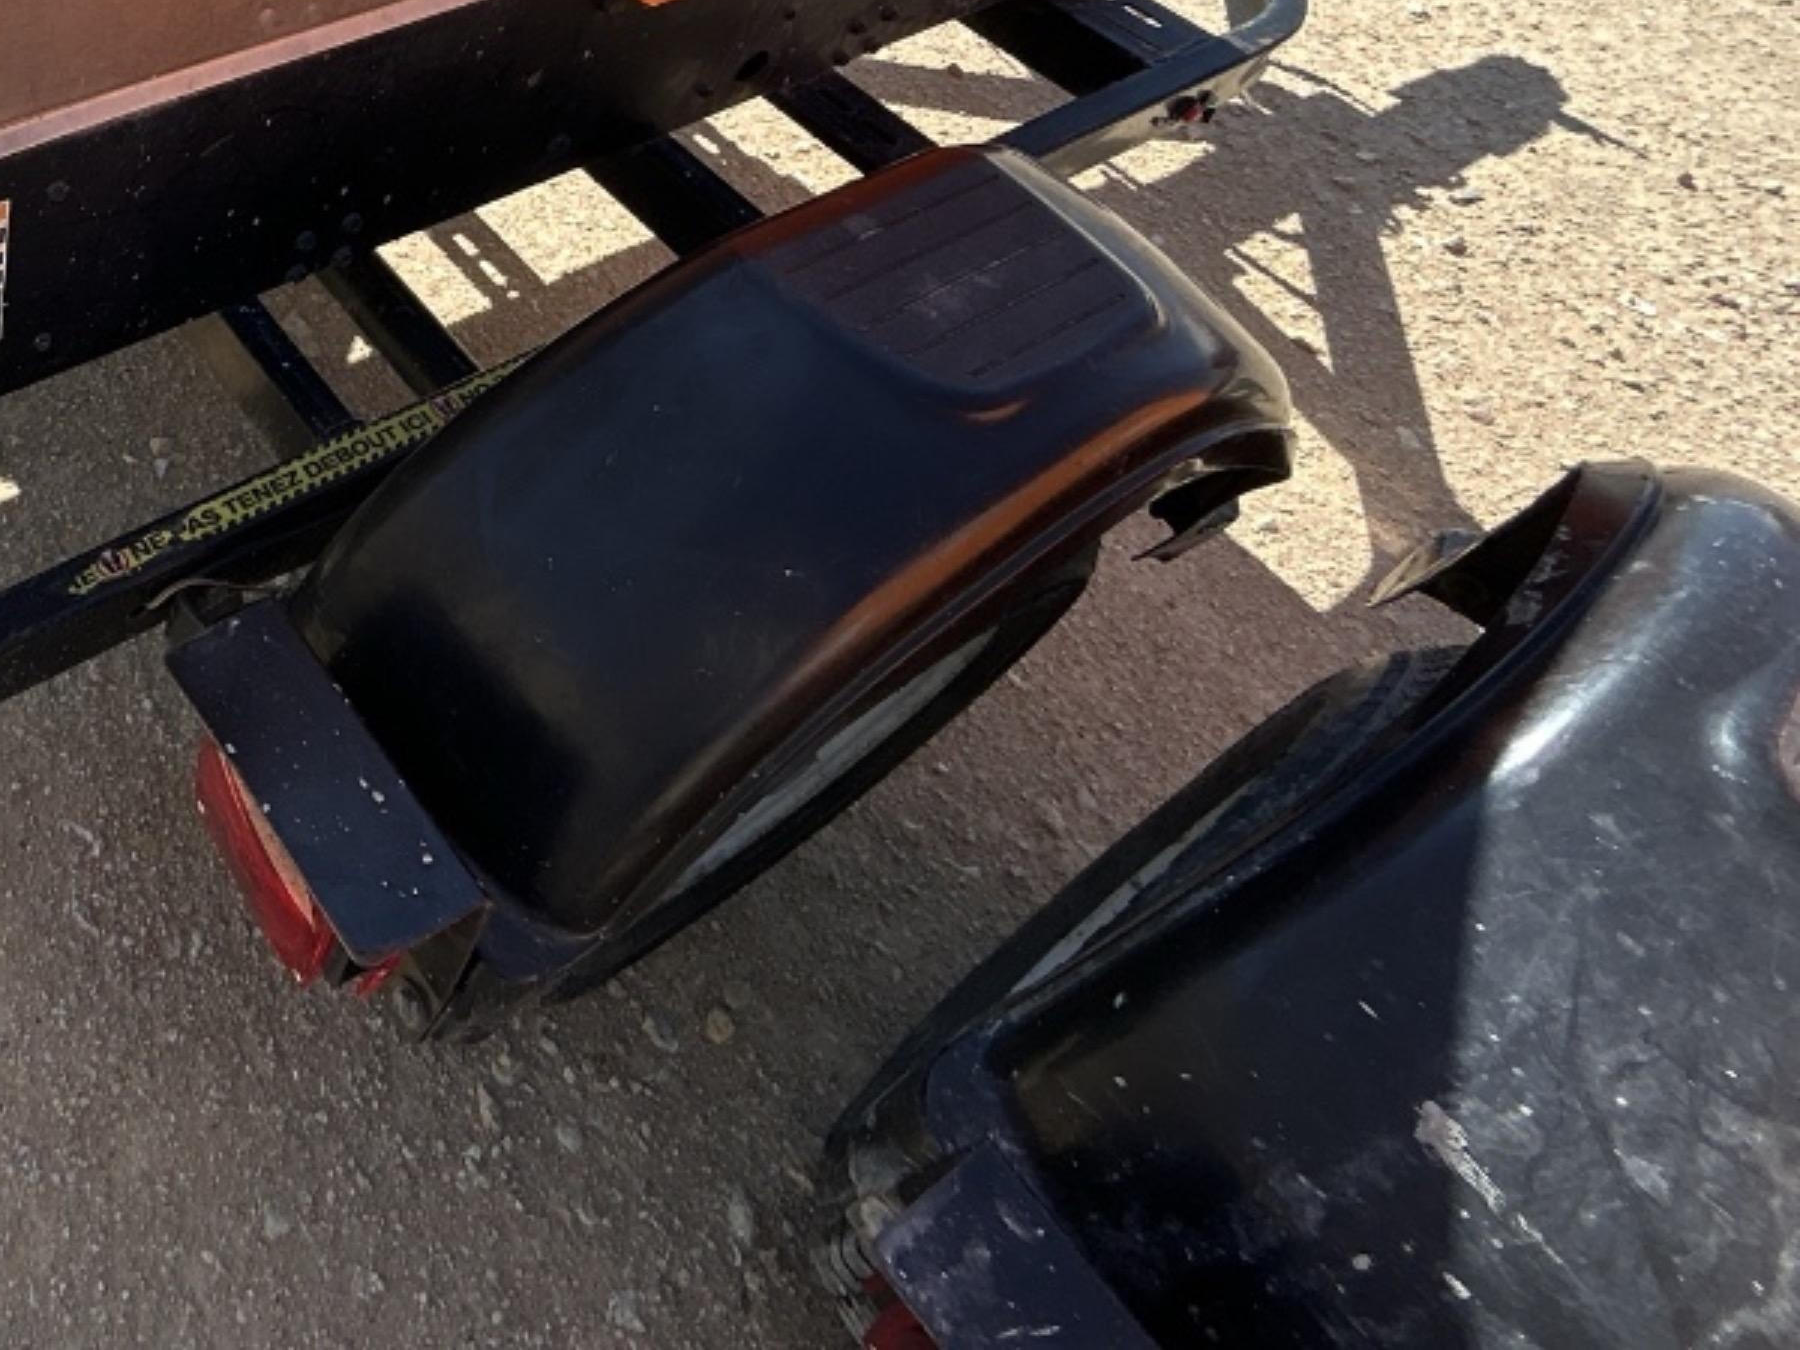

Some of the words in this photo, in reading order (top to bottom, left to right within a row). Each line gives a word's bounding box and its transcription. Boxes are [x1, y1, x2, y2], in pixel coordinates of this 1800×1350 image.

[181, 508, 221, 535] AS
[221, 469, 302, 514] TENEZ
[303, 425, 397, 478] DEBOUT
[400, 410, 432, 433] ICI
